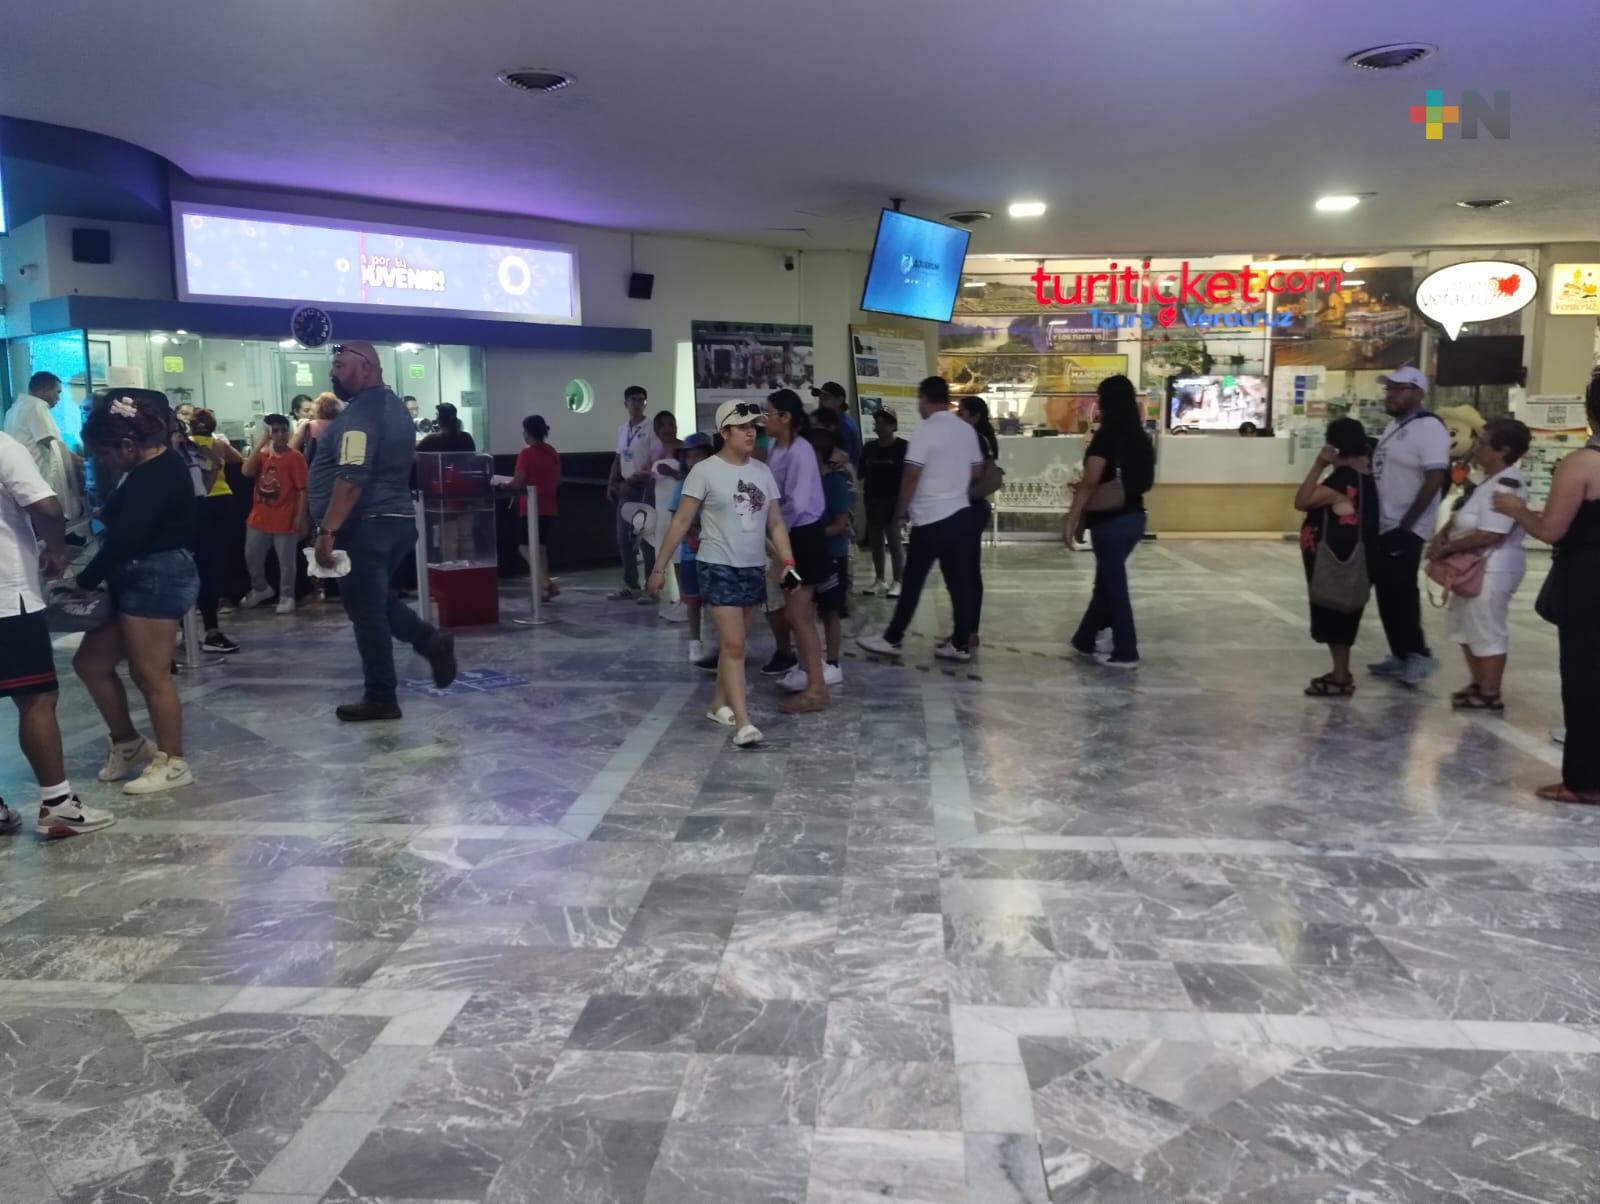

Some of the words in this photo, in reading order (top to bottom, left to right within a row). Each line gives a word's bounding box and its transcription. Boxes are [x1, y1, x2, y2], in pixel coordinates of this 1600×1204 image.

[1031, 261, 1343, 305] turiticket.com
[1088, 308, 1153, 329] Tours
[1181, 308, 1293, 329] Veracruz
